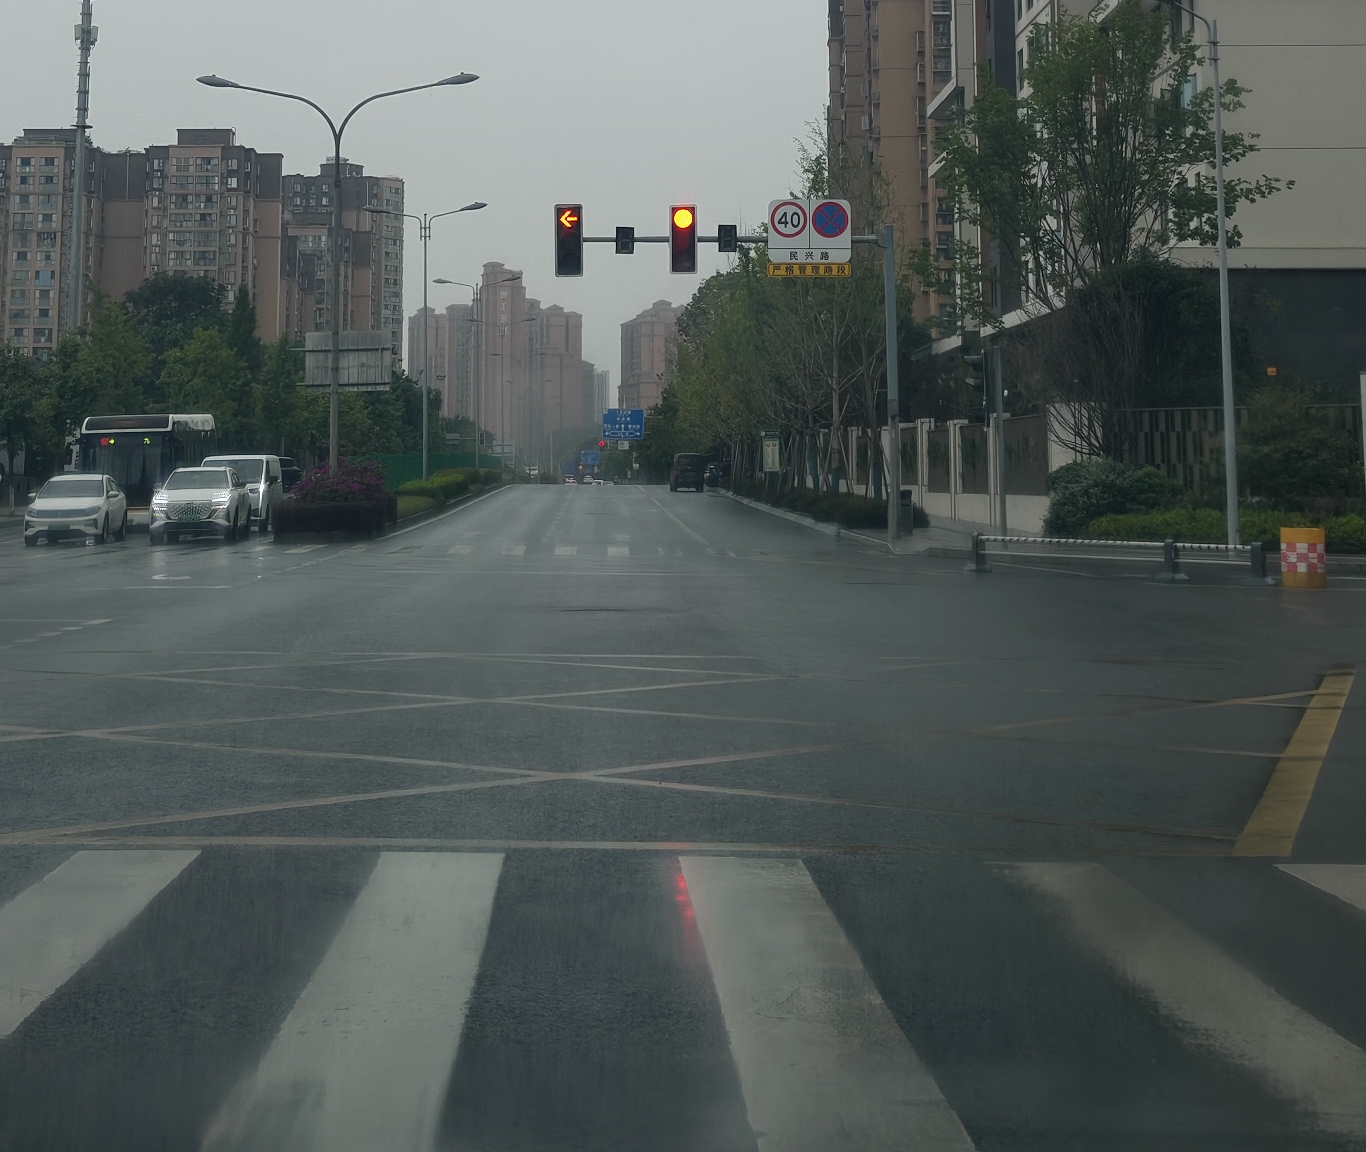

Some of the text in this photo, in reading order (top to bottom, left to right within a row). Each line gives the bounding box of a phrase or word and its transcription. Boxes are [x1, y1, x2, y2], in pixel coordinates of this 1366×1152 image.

[778, 212, 800, 228] 40
[789, 251, 829, 260] 民兴路
[772, 265, 847, 275] 严格管理路段
